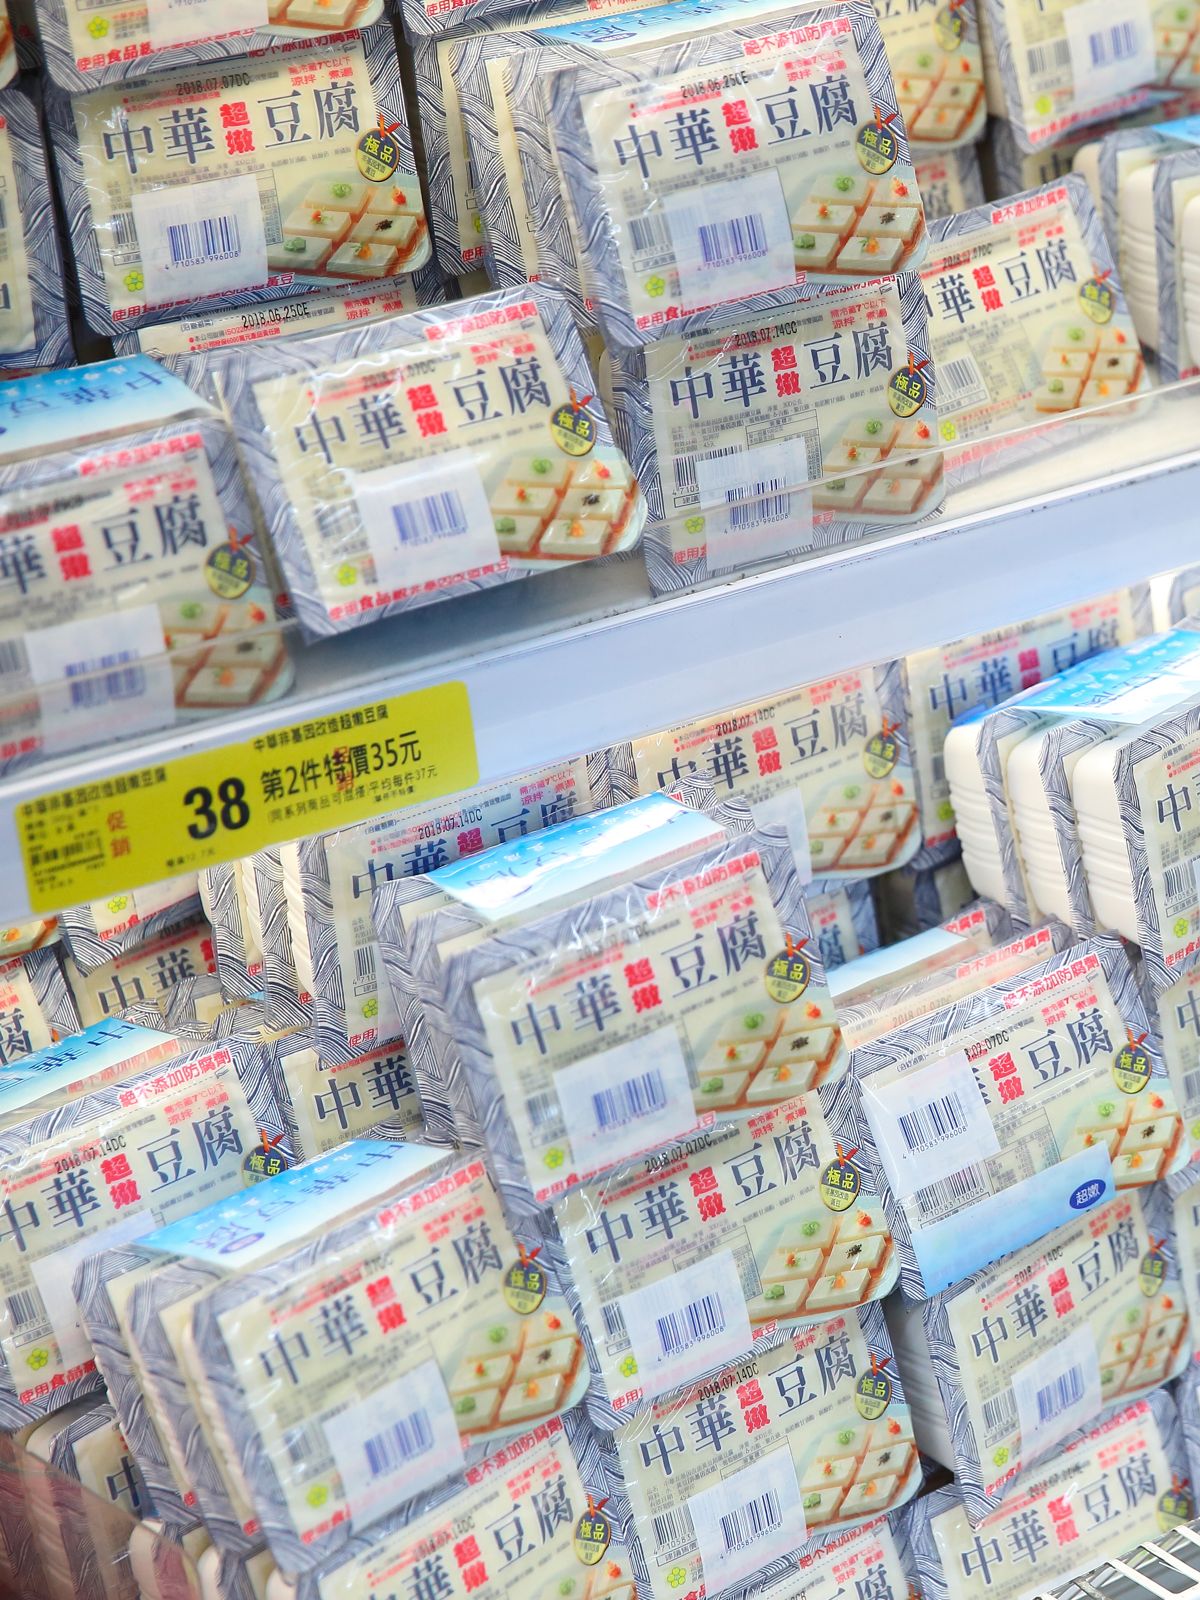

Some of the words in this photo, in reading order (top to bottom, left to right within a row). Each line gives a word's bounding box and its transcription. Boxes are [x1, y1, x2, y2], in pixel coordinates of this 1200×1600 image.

[743, 18, 852, 57] 絕不添加防腐劑
[175, 72, 251, 97] 2018.07.07DC
[102, 107, 216, 175] 中華
[218, 101, 256, 157] 超嫩
[256, 81, 361, 150] 豆腐
[364, 134, 394, 164] 極品
[612, 107, 722, 180] 中華
[720, 100, 760, 155] 超嫩
[756, 75, 859, 146] 豆腐
[862, 127, 894, 155] 極品
[972, 264, 1003, 313] 超嫩
[998, 238, 1078, 305] 豆腐
[241, 302, 310, 329] 2018.06.25CE
[669, 352, 768, 420] 中華
[770, 345, 802, 398] 超嫩
[802, 321, 893, 390] 豆腐
[895, 373, 921, 399] 極品
[294, 395, 407, 465] 中華
[404, 383, 449, 439] 超嫩
[443, 357, 553, 431] 豆腐
[91, 494, 210, 572] 豆腐
[752, 725, 783, 778] 超嫩
[783, 692, 869, 767] 豆腐
[183, 776, 251, 841] 38
[510, 973, 622, 1056] 中華
[622, 956, 663, 1014] 超嫩
[660, 909, 768, 999] 豆腐
[771, 957, 805, 982] 極品
[1003, 952, 1102, 1010] 絕不添加防腐劑
[118, 1048, 232, 1109] 絕不添加防腐劑
[314, 1054, 417, 1131] 中華
[988, 1051, 1025, 1104] 超嫩
[1020, 1007, 1114, 1090] 豆腐
[1119, 1051, 1147, 1072] 極品
[99, 1153, 143, 1211] 超嫩
[137, 1105, 245, 1194] 豆腐
[584, 1181, 690, 1265] 中華
[688, 1166, 727, 1223] 超嫩
[722, 1120, 822, 1207] 豆腐
[826, 1166, 855, 1190] 極品
[1074, 1181, 1101, 1207] 超嫩
[259, 1294, 370, 1386] 中華
[401, 1219, 505, 1317] 豆腐
[970, 1283, 1048, 1364] 中華
[1072, 1215, 1140, 1302] 豆腐
[639, 1393, 738, 1477] 中華
[735, 1379, 771, 1434] 超嫩
[767, 1332, 860, 1419] 豆腐
[699, 1362, 760, 1401] 2018.07.14DC
[860, 1375, 887, 1397] 極品
[464, 1414, 565, 1487] 絕不添加防腐劑
[484, 1474, 575, 1574] 豆腐
[579, 1520, 605, 1542] 極品
[960, 1508, 1049, 1586] 中華
[1076, 1452, 1158, 1532] 豆腐
